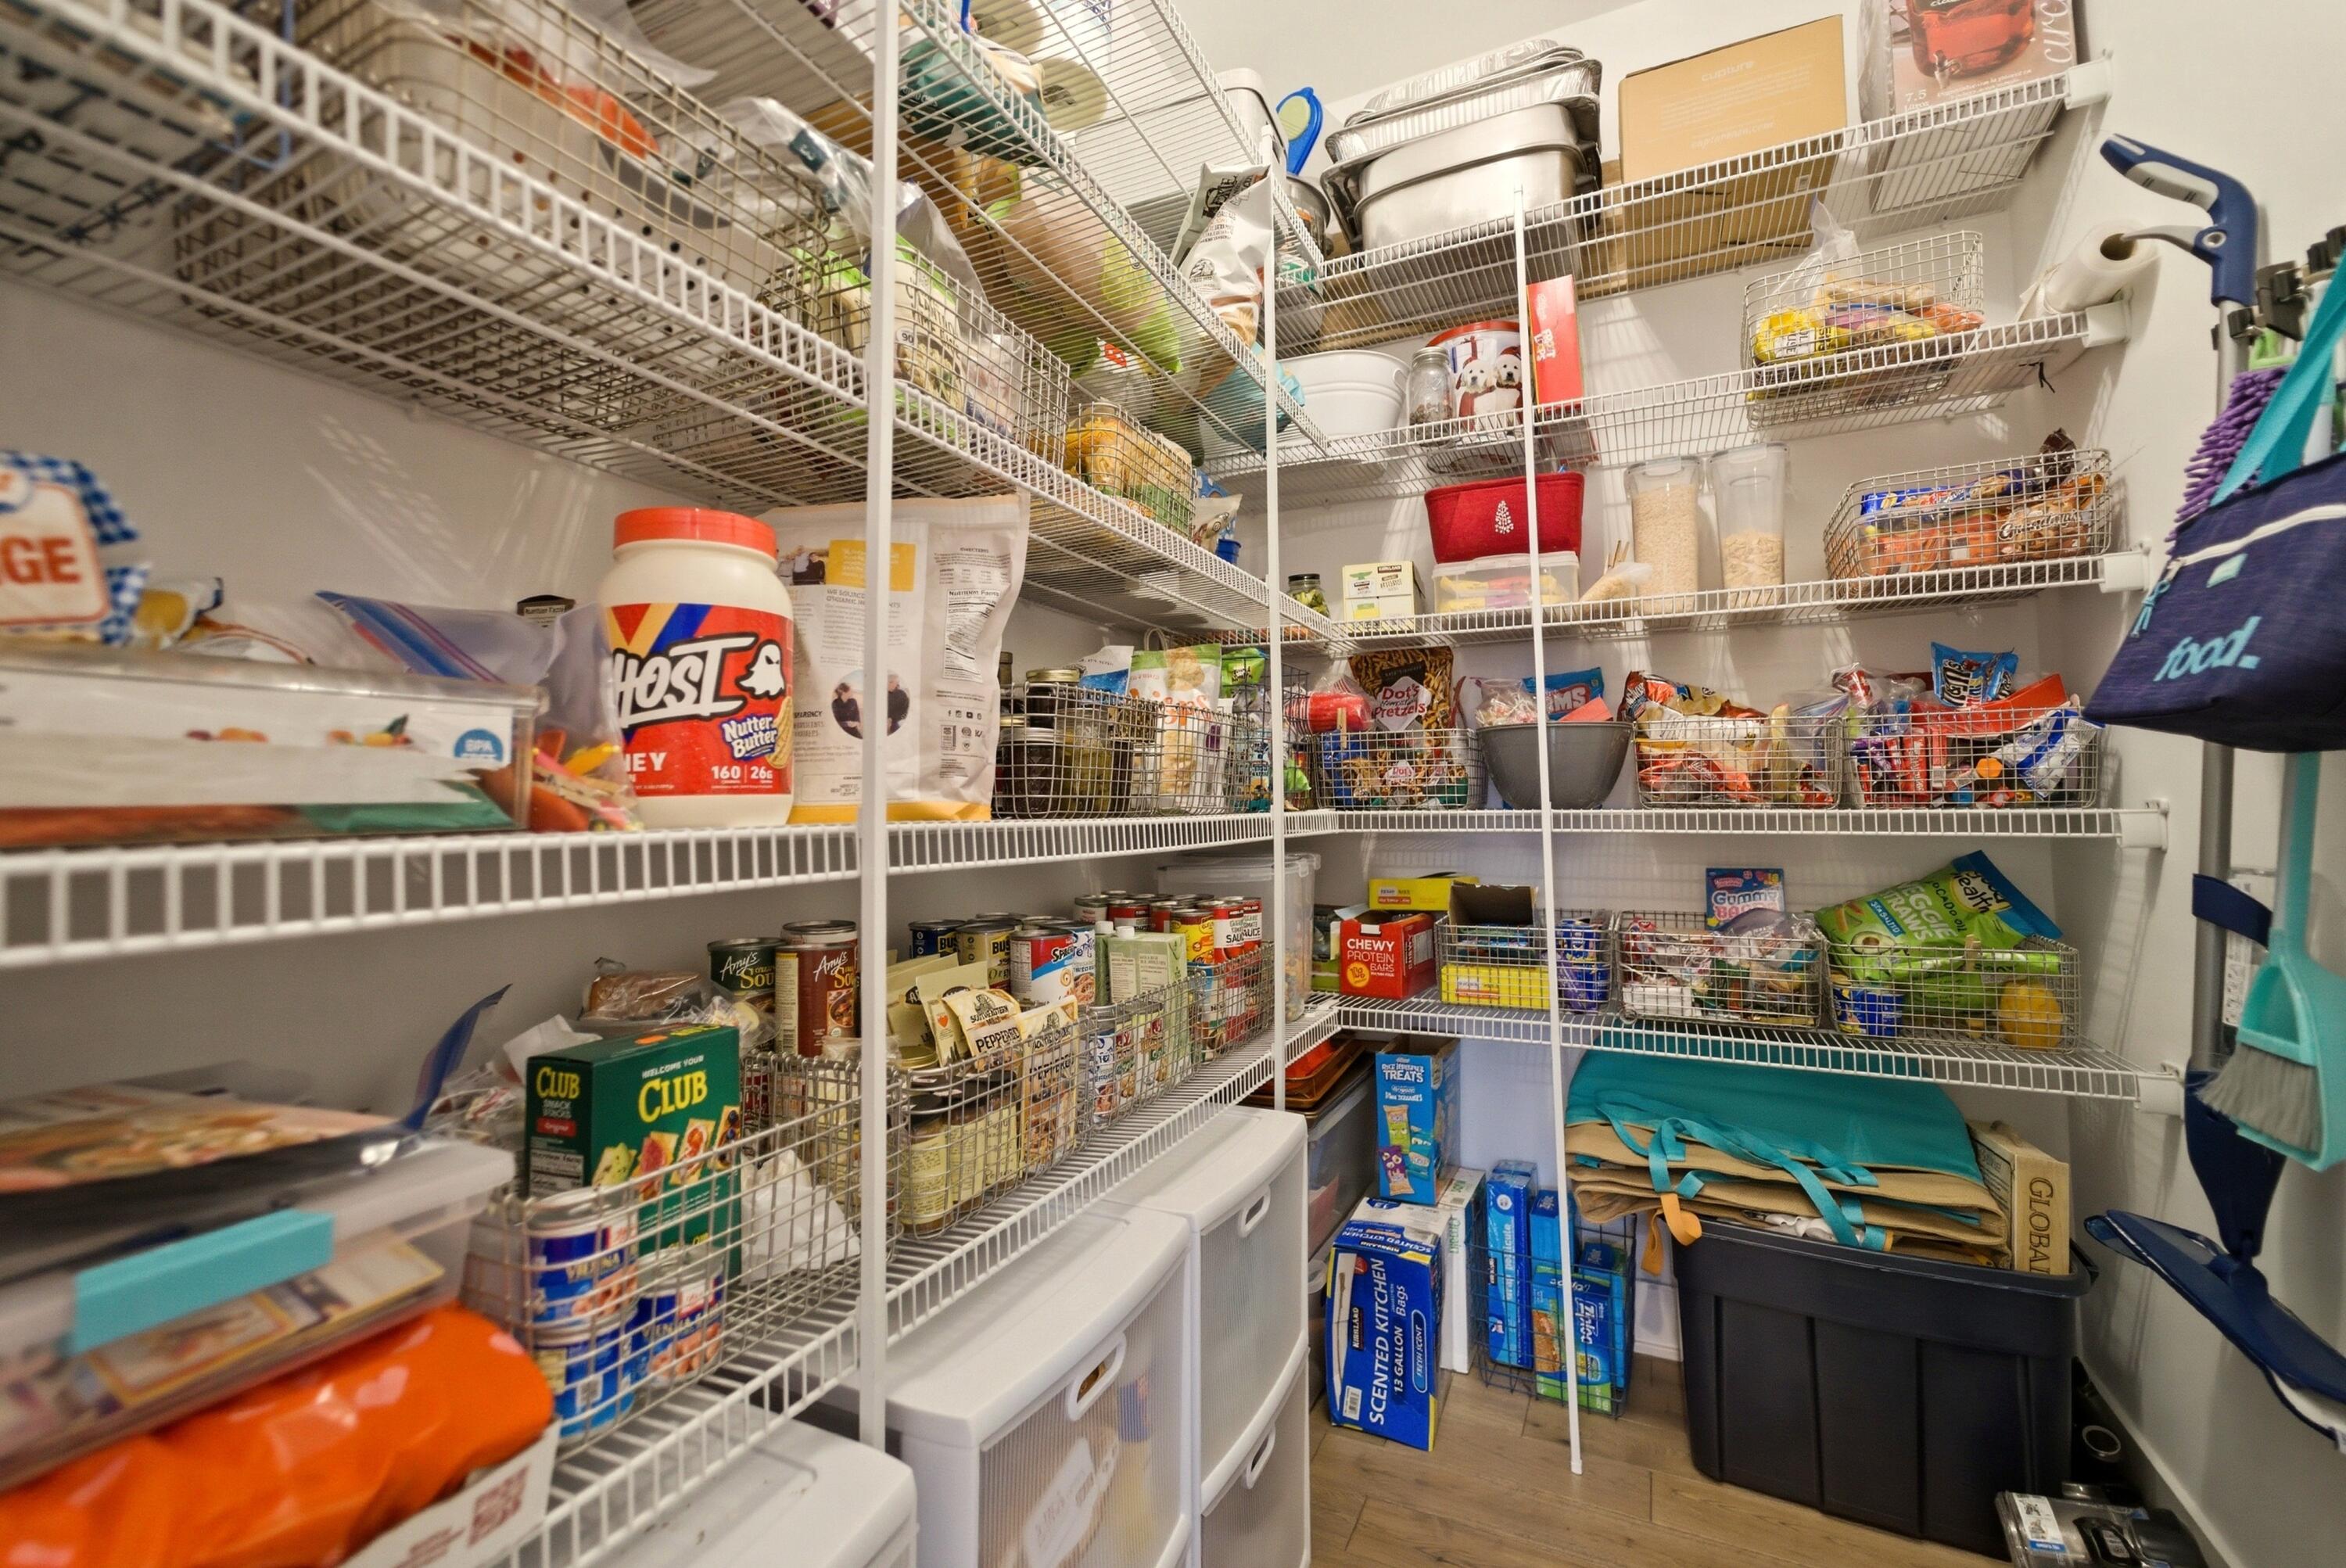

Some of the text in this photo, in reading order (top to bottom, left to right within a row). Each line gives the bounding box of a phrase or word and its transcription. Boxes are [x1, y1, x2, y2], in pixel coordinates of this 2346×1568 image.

[2154, 616, 2262, 683] food.
[1383, 684, 1421, 701] Dot's
[1373, 701, 1426, 719] Pretzels
[722, 716, 773, 743] Nutter
[731, 730, 777, 759] Butter
[712, 766, 741, 779] 160
[1347, 938, 1395, 952] CHEWY
[1347, 950, 1394, 963] PROTEIN
[719, 951, 760, 982] Amy's
[813, 951, 848, 983] Amy's
[1370, 963, 1395, 973] BARS
[976, 1027, 1021, 1053] PEPPERED
[642, 1061, 681, 1079] WELCOME
[1383, 1070, 1424, 1083] TREATS
[536, 1067, 580, 1100] CLUB
[638, 1070, 708, 1123] CLUB
[1369, 1258, 1390, 1426] SCENTED KITCHEN
[1394, 1285, 1408, 1394] 13 GALLON Bags
